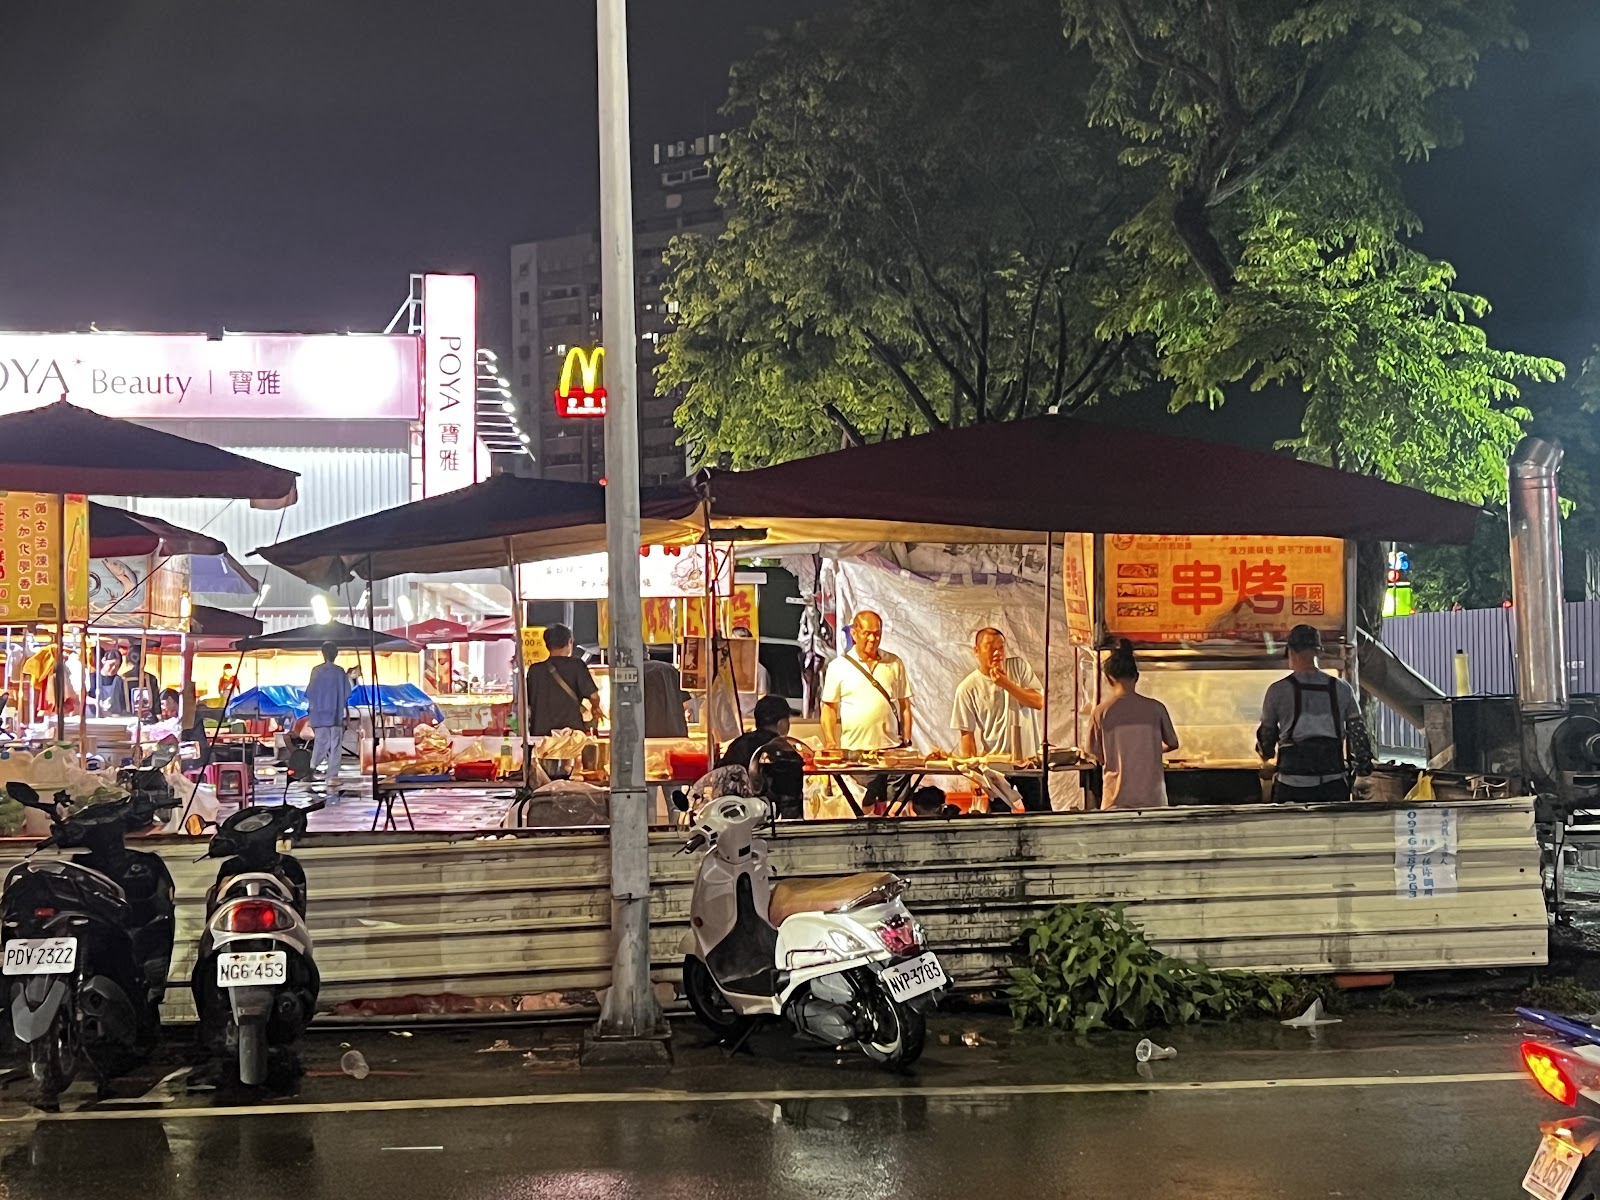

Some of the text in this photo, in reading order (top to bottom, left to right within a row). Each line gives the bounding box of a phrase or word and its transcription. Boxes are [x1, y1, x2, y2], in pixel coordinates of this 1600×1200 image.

[0, 358, 281, 403] YA Beauty 寶雅
[439, 336, 462, 412] POYA
[438, 423, 461, 471] 寶雅
[18, 508, 31, 607] 不加化學香料
[1171, 559, 1287, 615] 串烤
[220, 962, 284, 981] NG6-453
